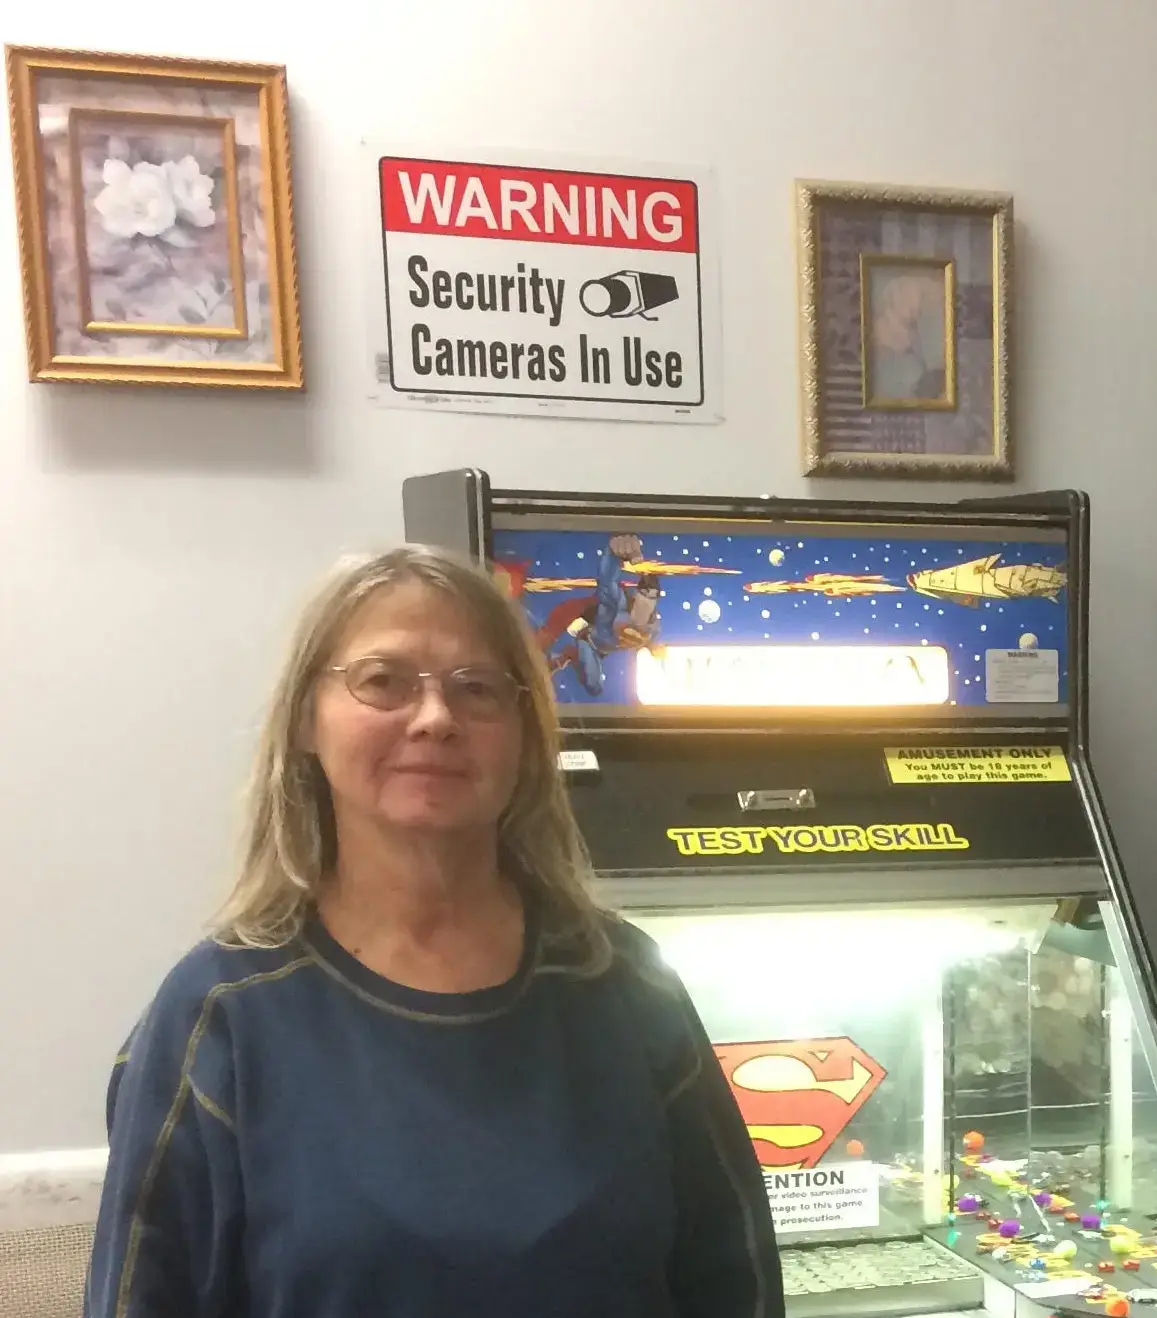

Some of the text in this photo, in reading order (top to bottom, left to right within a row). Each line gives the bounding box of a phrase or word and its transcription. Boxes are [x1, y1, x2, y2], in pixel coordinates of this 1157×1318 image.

[398, 170, 683, 243] WARNING
[407, 254, 566, 327] Security
[411, 323, 683, 389] Cameras In Use
[897, 747, 1054, 760] AMUSEMENT ONLY
[905, 763, 928, 771] You
[931, 763, 966, 771] MUST
[969, 762, 985, 771] be
[1006, 763, 1037, 772] years
[1041, 761, 1053, 770] of
[917, 771, 1048, 782] age to play this game.
[669, 825, 968, 853] TEST YOUR SKILL
[781, 1191, 808, 1200] video
[809, 1187, 868, 1198] surveillance
[800, 1203, 811, 1211] to
[813, 1202, 833, 1210] this
[836, 1200, 863, 1210] game
